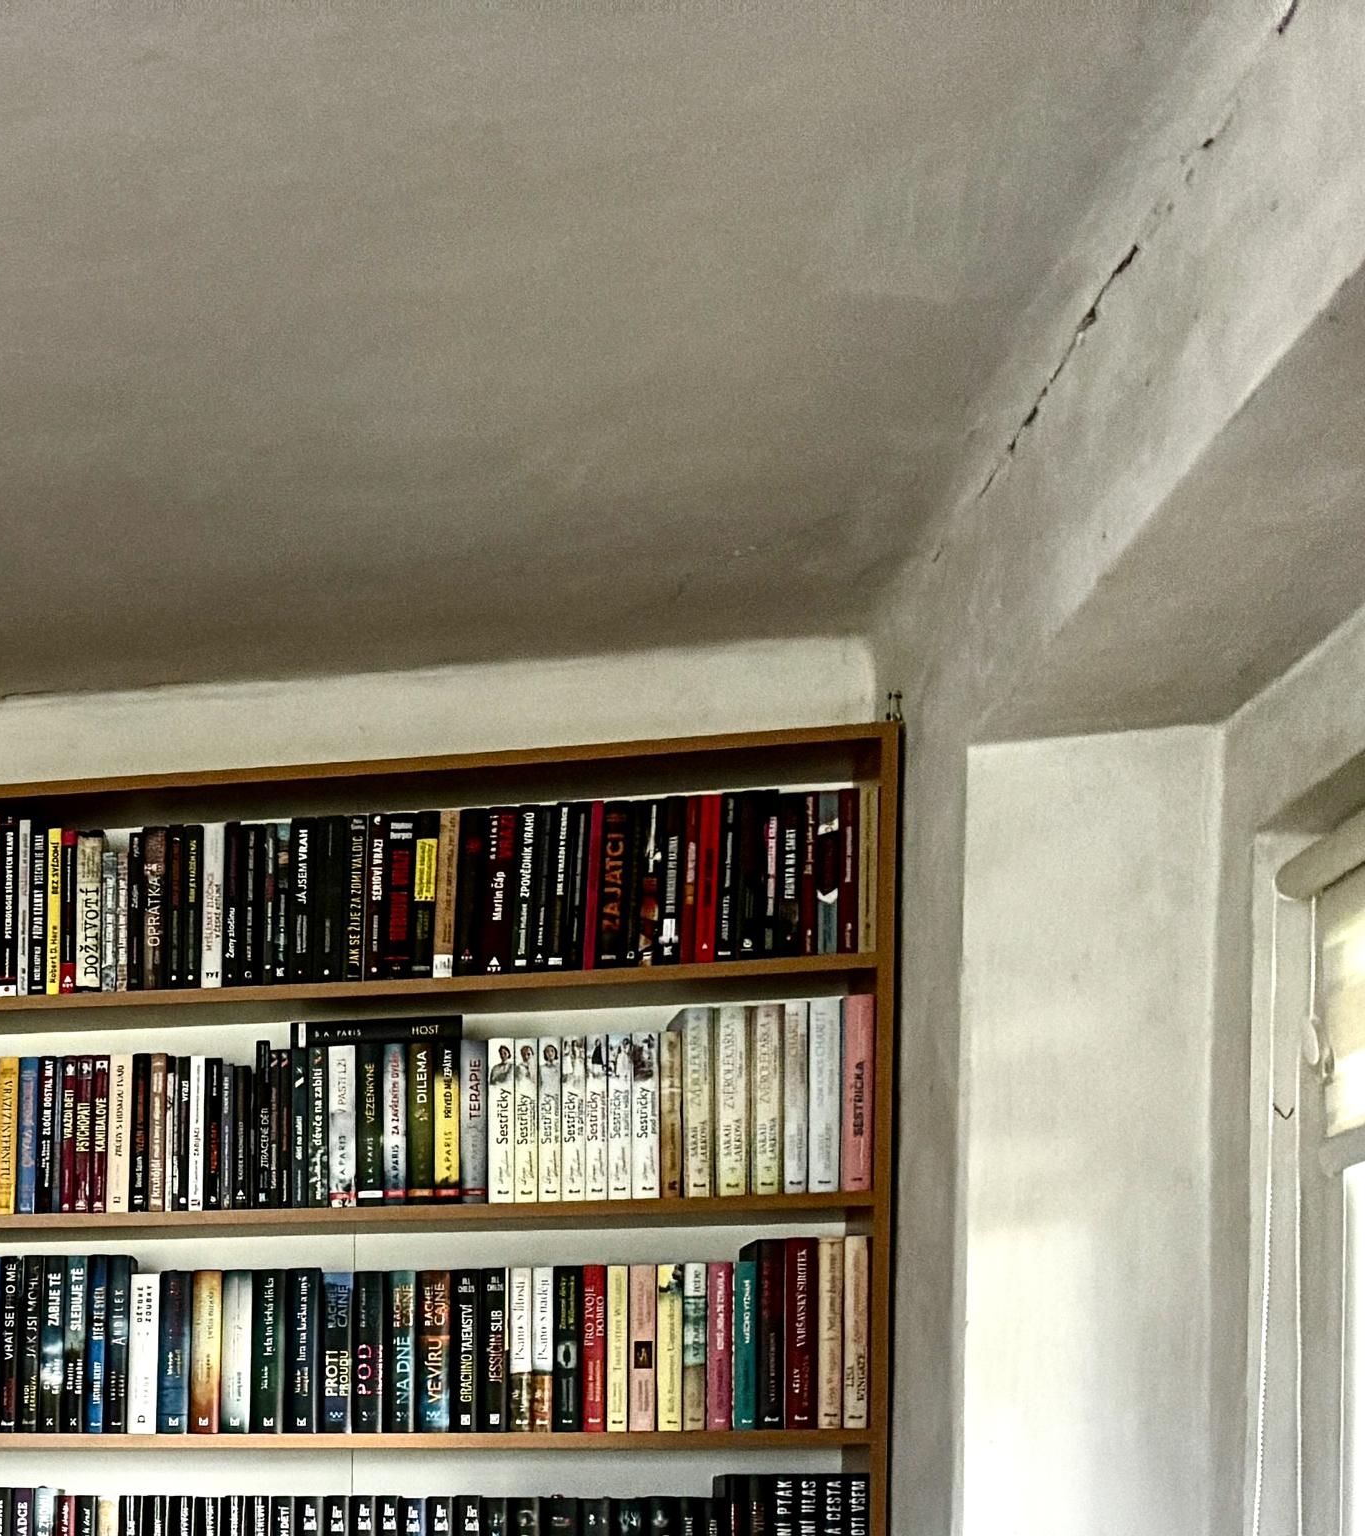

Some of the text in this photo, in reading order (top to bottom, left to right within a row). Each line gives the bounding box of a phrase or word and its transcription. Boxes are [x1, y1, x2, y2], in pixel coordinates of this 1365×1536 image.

[298, 829, 308, 861] VRAH
[351, 836, 363, 869] VALDIC
[520, 812, 535, 898] ZPOVĚDNÍK VRAHŮ
[295, 891, 307, 904] JÁ
[298, 863, 307, 889] JSEM
[143, 877, 162, 947] OPRÁTKA
[347, 912, 361, 931] ŽIJE
[350, 897, 361, 909] ZA
[50, 946, 58, 954] D.
[79, 886, 99, 977] DOŽIVOTÍ
[349, 934, 360, 945] SE
[50, 956, 58, 984] Robert
[349, 948, 359, 966] JAK
[411, 1024, 439, 1036] HOST
[416, 1051, 427, 1103] DILEMA
[469, 1060, 480, 1120] TERAPIE
[76, 1103, 90, 1152] PSYCHOPATI
[311, 1068, 322, 1146] děvče na zabití
[496, 1088, 512, 1144] Sestřičky
[48, 1273, 61, 1326] ZABIJE TĚ
[459, 1304, 473, 1402] GRACIINO TAJEMSTVÍ
[486, 1310, 503, 1383] JESSIČIN SLIB
[325, 1351, 338, 1396] PROTI
[339, 1351, 349, 1397] PROUDU
[393, 1336, 411, 1404] NA DNĚ
[775, 1481, 792, 1515] PTÁK
